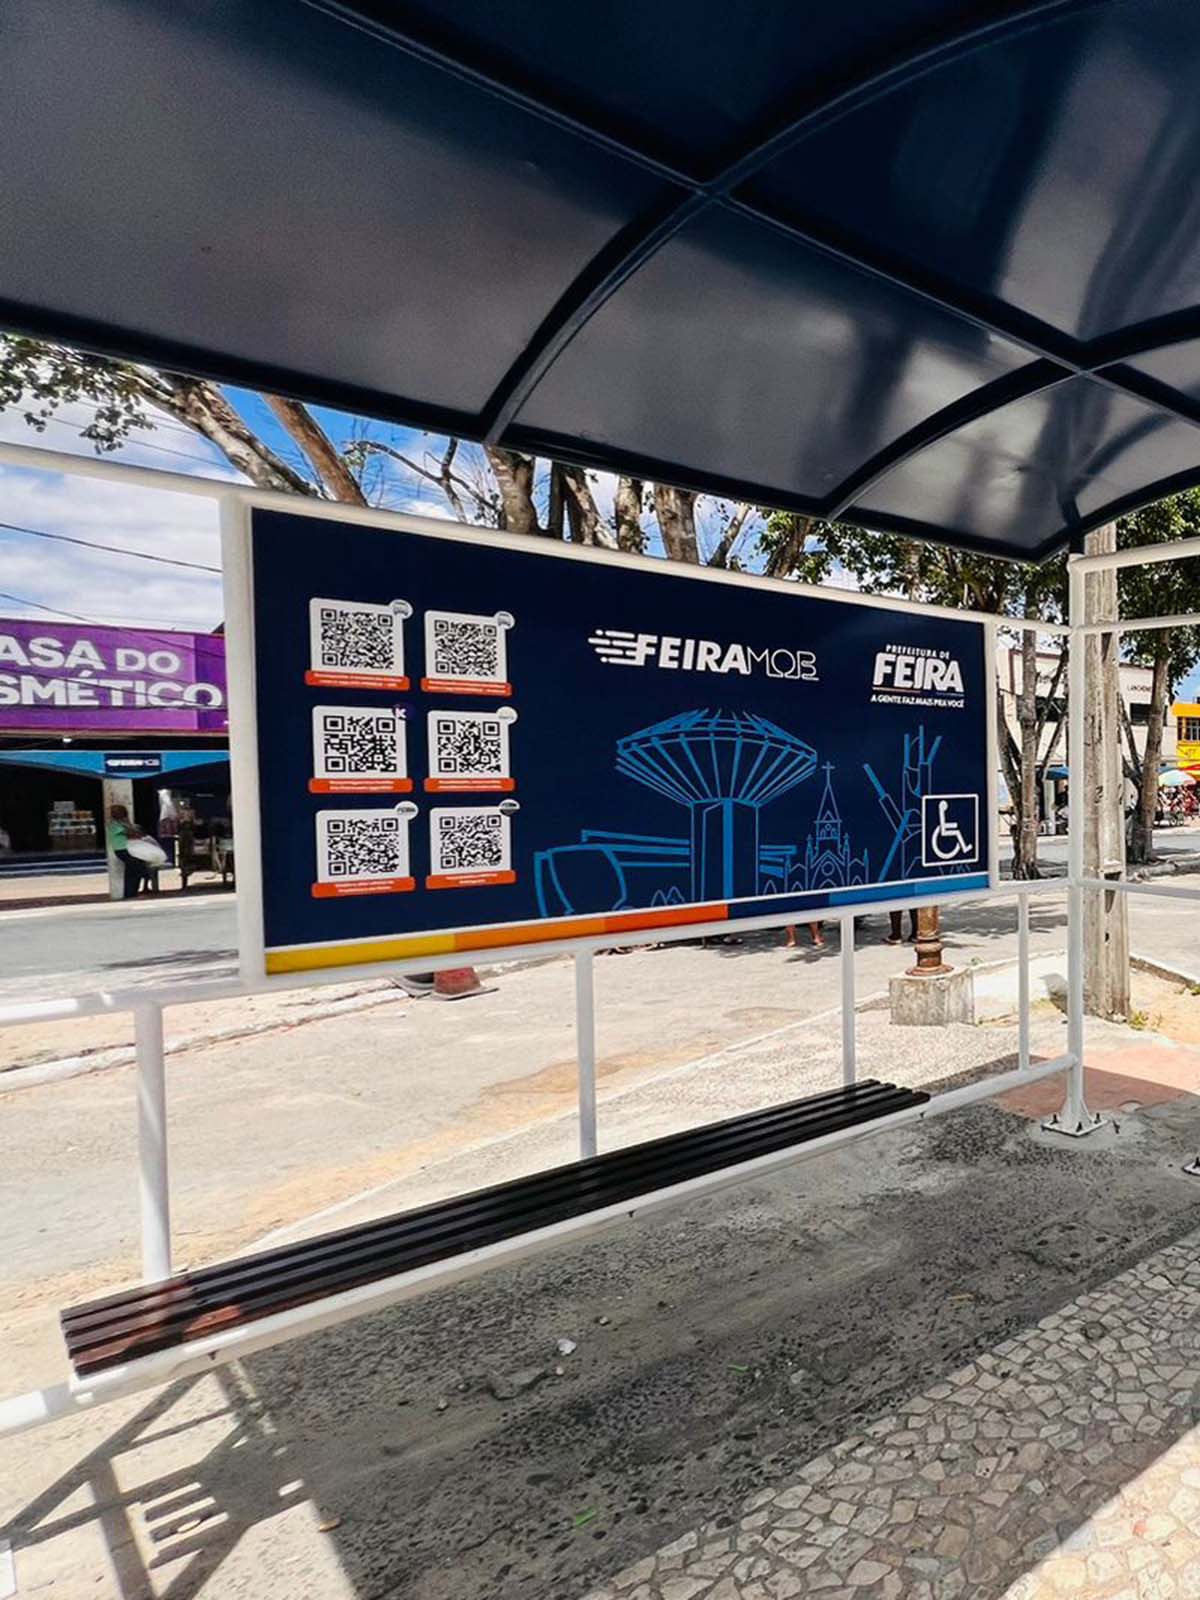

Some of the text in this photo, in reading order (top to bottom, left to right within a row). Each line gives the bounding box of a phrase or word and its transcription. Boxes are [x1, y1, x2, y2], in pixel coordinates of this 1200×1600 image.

[0, 635, 181, 674] ASA DO
[886, 644, 950, 660] PREFEITURA DE
[872, 652, 964, 692] FEIRA
